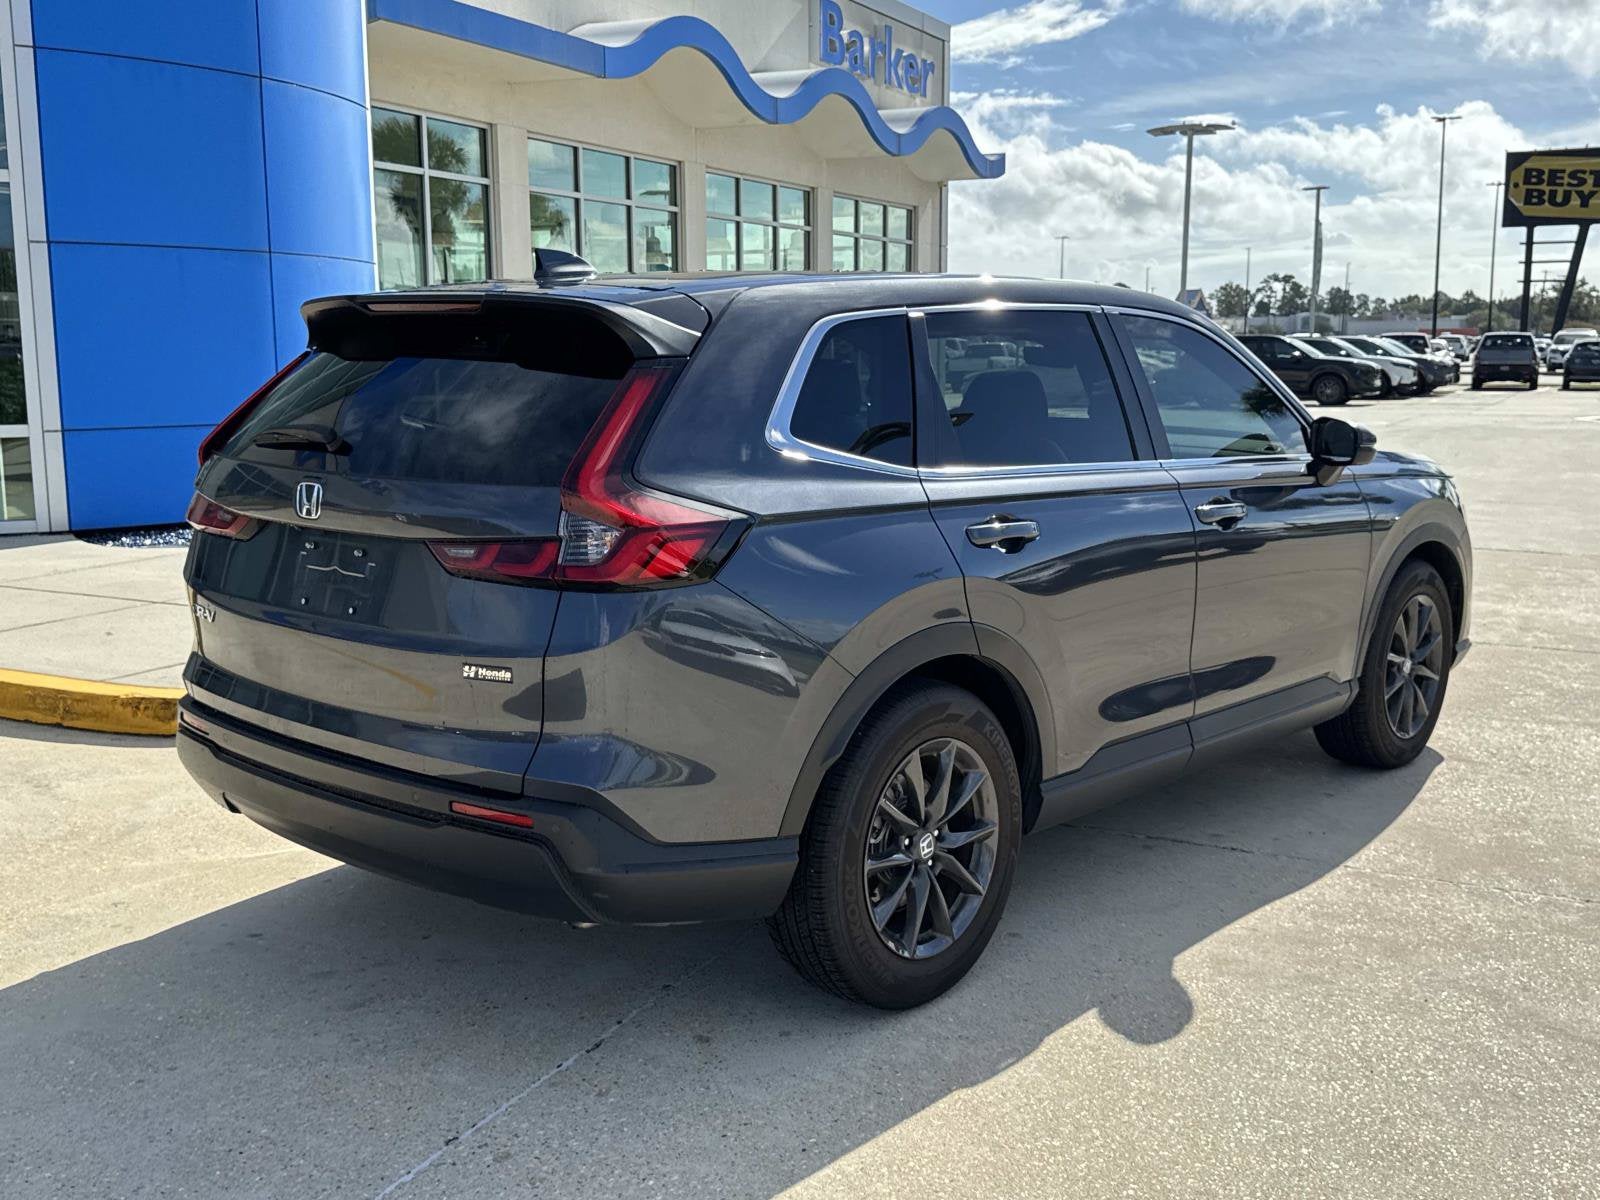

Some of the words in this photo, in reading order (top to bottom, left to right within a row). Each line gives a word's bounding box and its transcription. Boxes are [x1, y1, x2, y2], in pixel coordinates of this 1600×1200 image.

[820, 0, 935, 98] Barker
[1523, 189, 1598, 208] BUY
[478, 667, 512, 678] Honda
